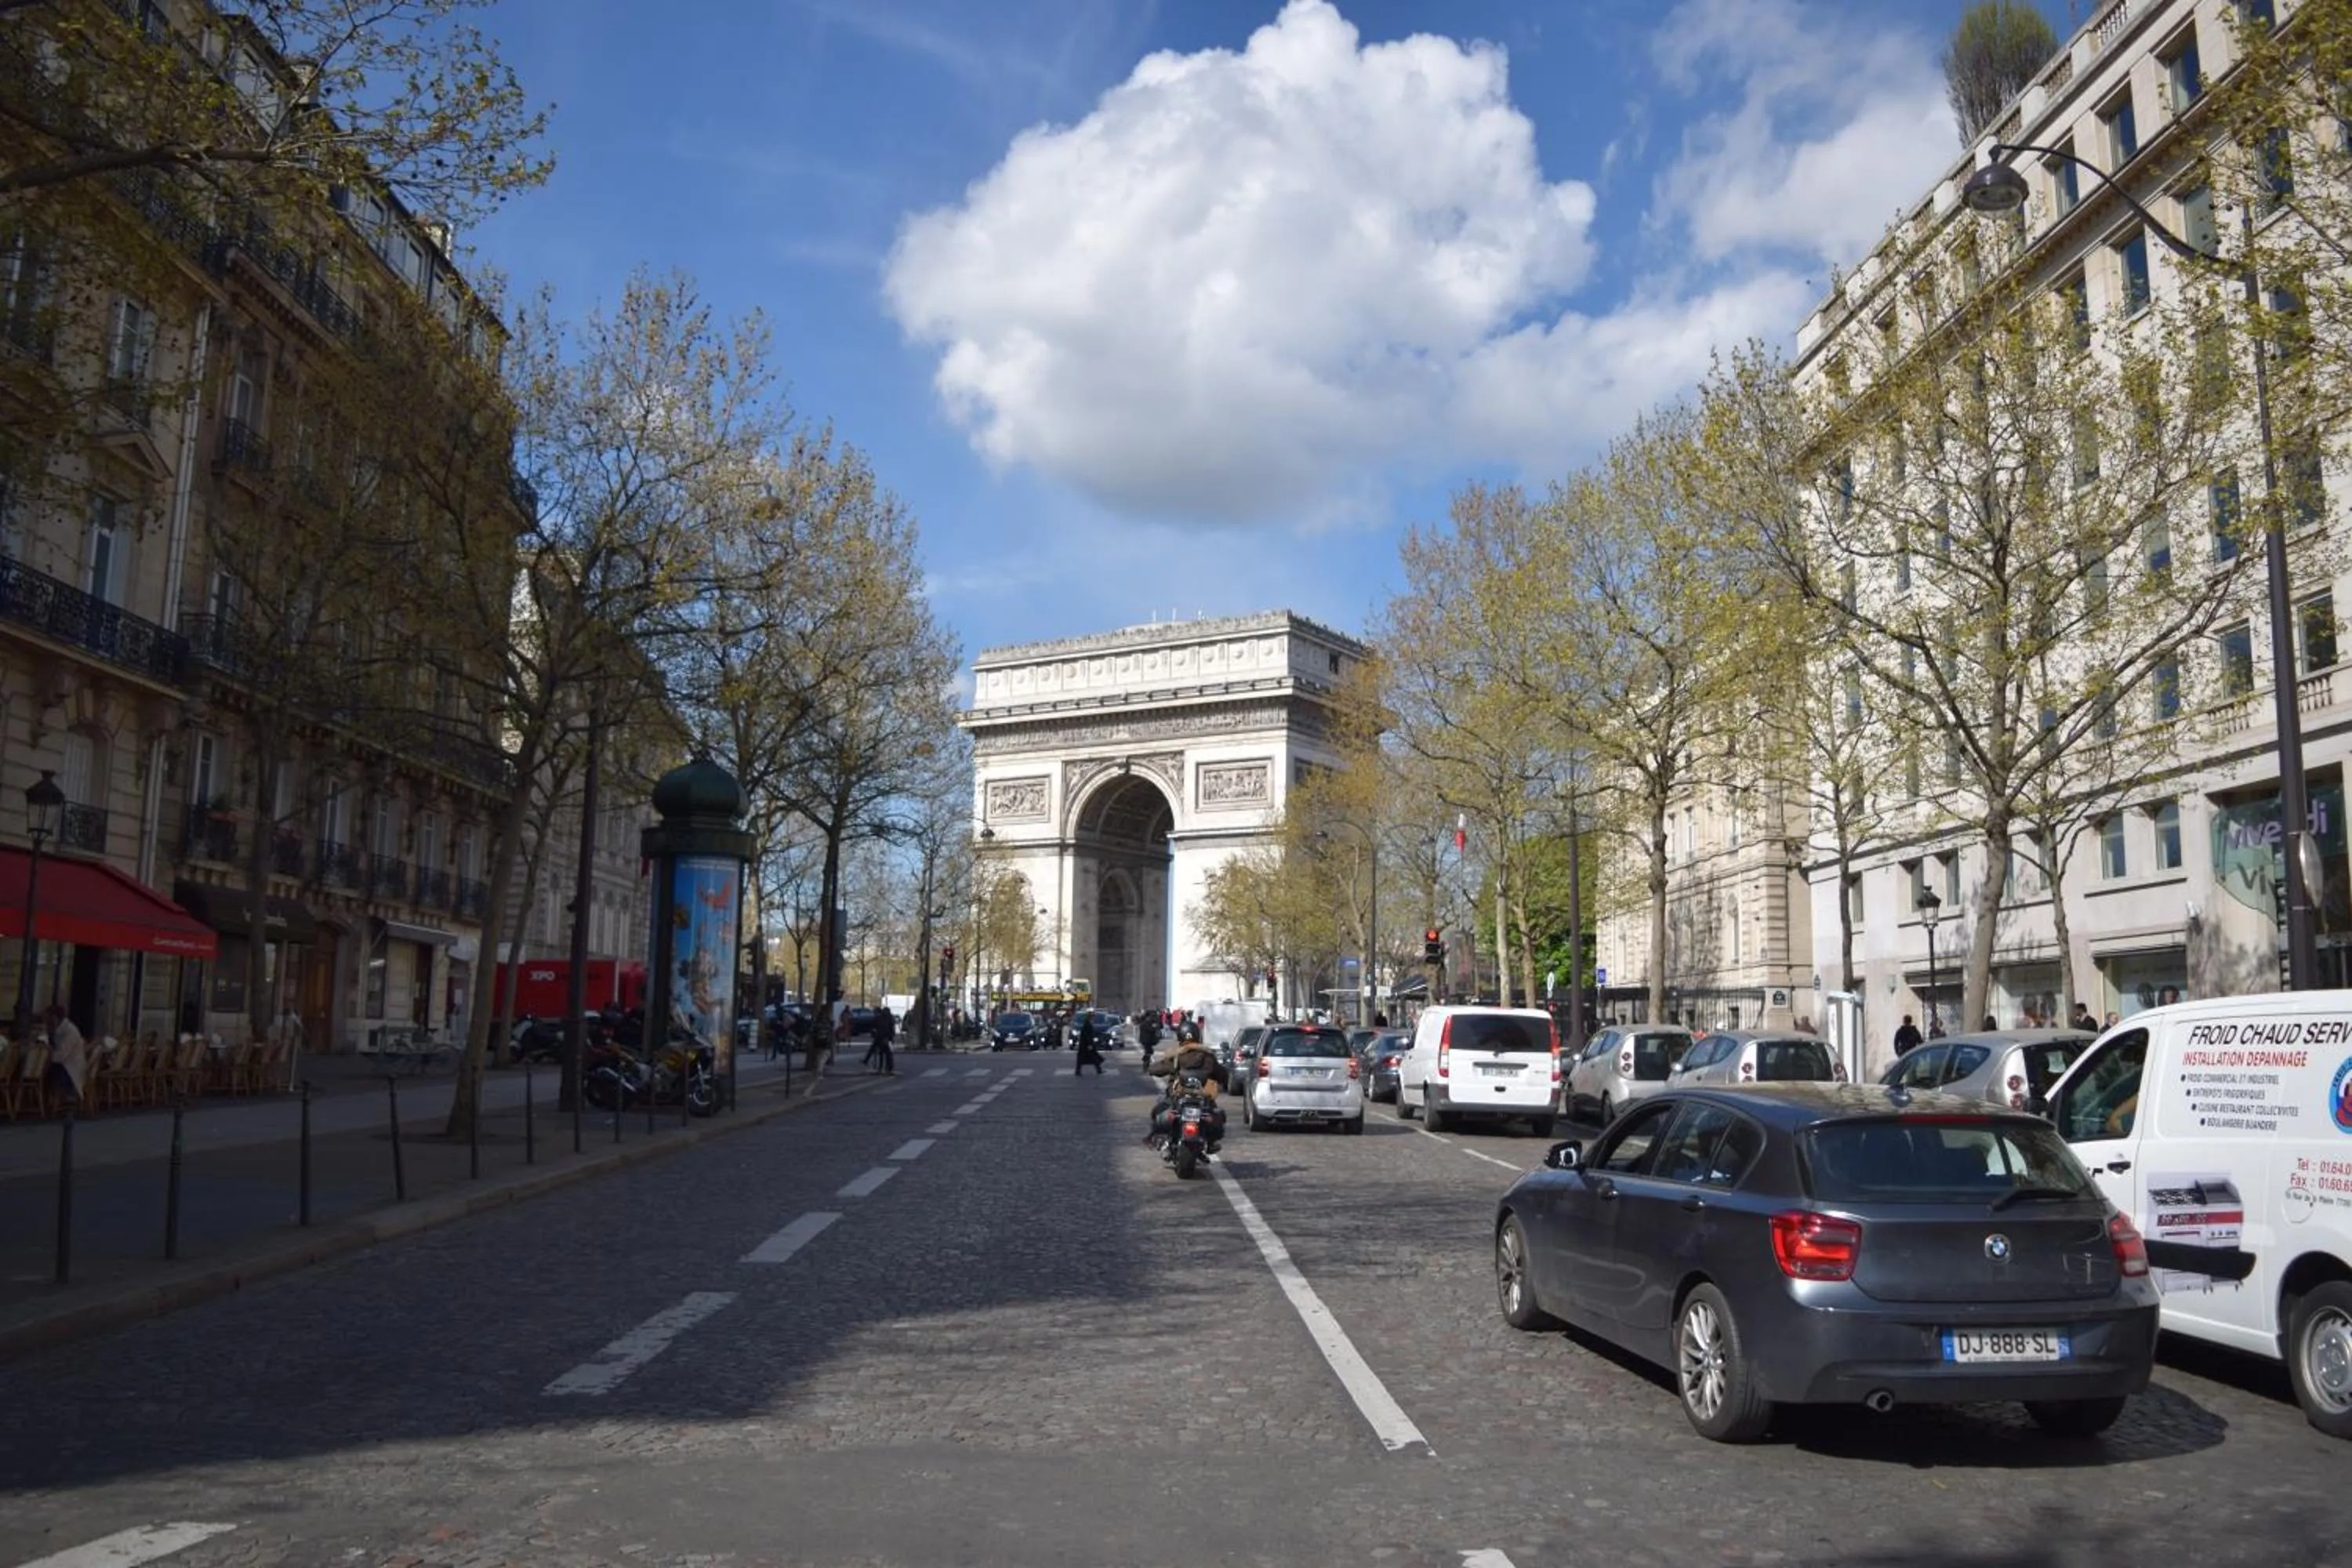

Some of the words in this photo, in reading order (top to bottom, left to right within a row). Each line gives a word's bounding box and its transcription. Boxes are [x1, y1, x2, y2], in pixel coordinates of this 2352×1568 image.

[2224, 799, 2327, 850] vivedi
[529, 971, 556, 981] XPO
[2188, 1025, 2238, 1045] FROID
[2240, 1023, 2302, 1045] CHAUD
[2303, 1022, 2352, 1044] SERV
[2183, 1051, 2245, 1066] INSTALLATION
[2246, 1051, 2308, 1067] DEPANNAGE
[2291, 1173, 2307, 1187] Fax
[1958, 1333, 2056, 1355] DJ-888-SL
